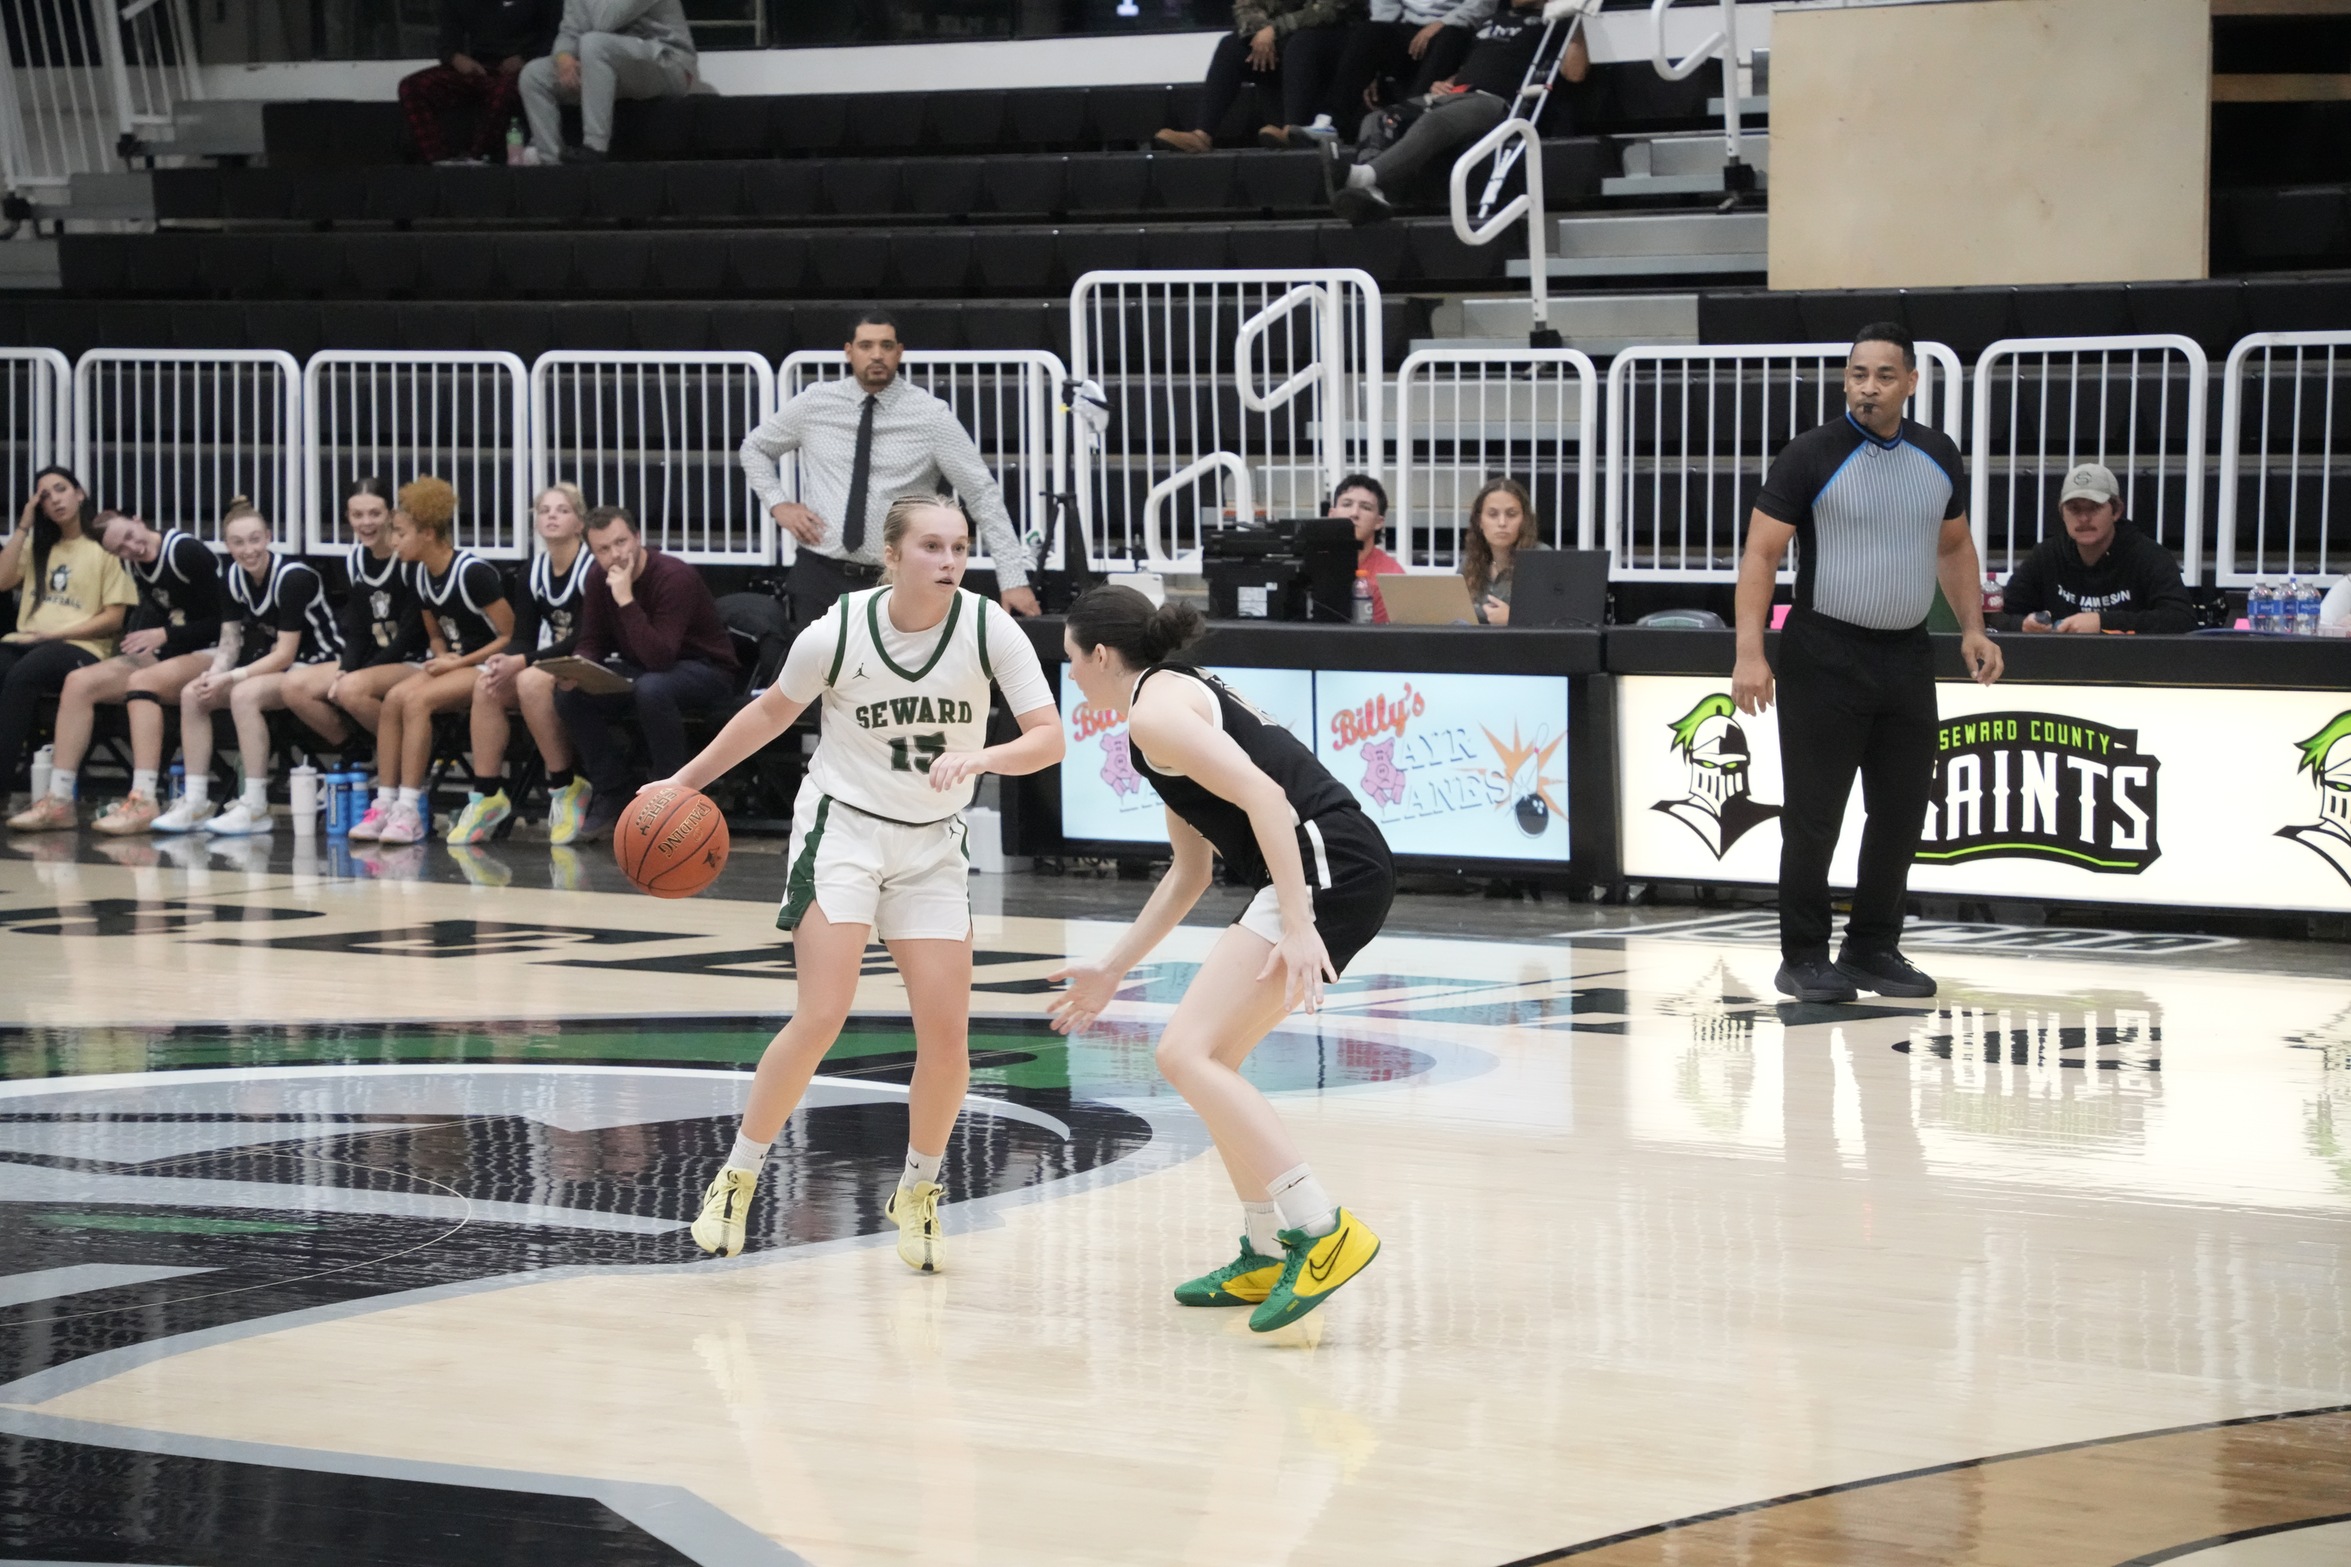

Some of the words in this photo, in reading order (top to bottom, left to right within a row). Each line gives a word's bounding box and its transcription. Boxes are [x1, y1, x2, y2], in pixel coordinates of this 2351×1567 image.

[855, 696, 973, 729] SEWARD
[1330, 682, 1426, 751] Billy's
[887, 731, 948, 775] 15
[1939, 720, 2018, 751] SEWARD
[2030, 720, 2110, 755] COUNTY
[639, 787, 678, 837] EGACY
[657, 798, 712, 858] SPALDING
